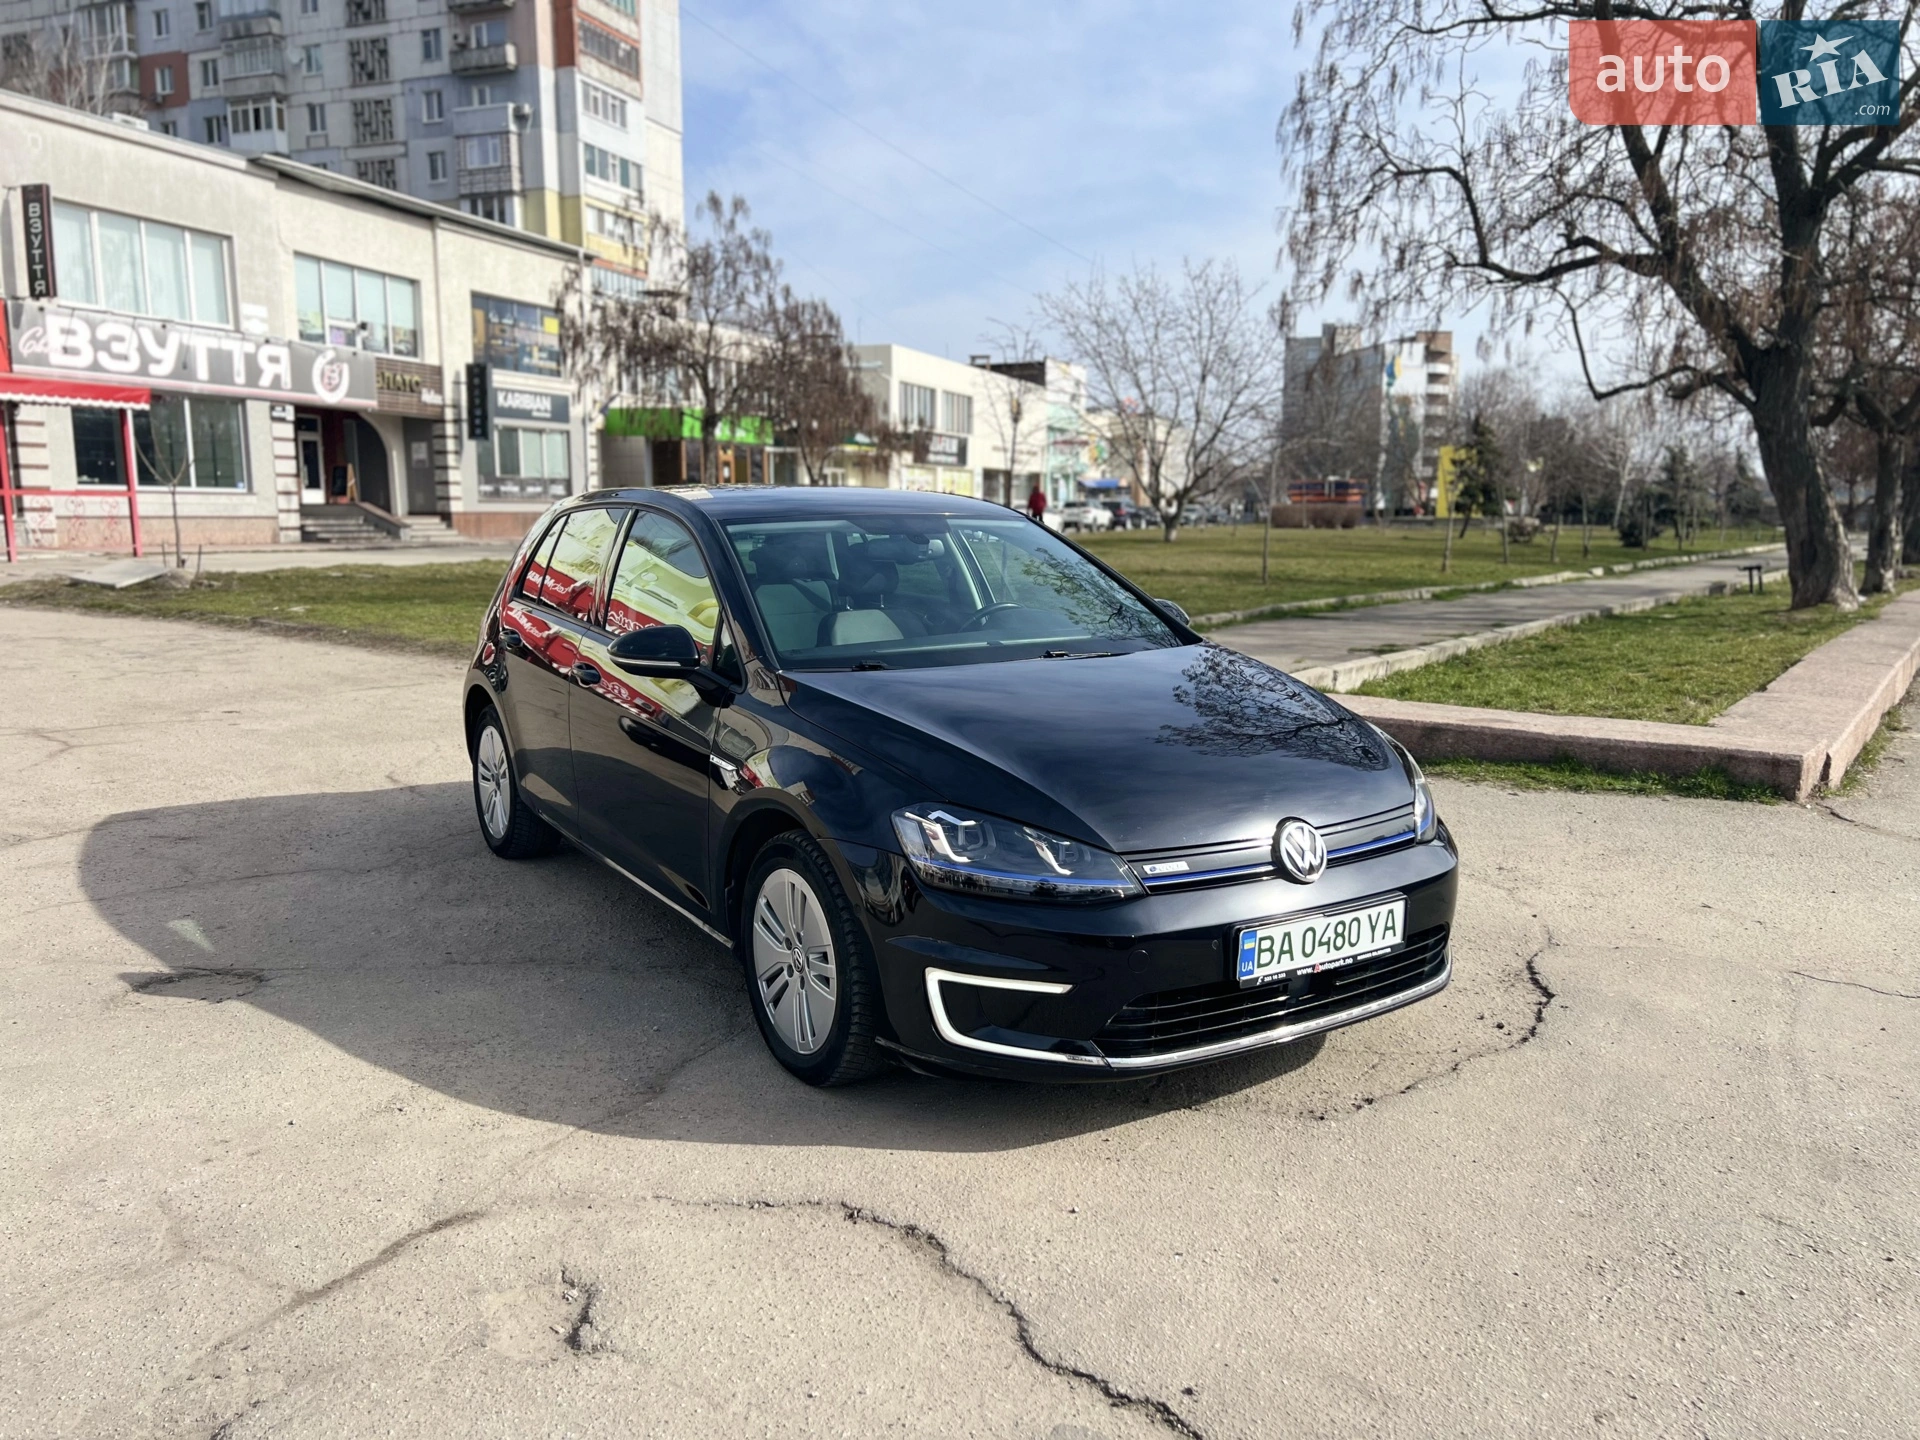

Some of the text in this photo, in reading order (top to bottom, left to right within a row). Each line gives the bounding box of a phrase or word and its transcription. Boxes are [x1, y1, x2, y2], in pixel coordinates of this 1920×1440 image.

[28, 203, 46, 295] ВЗУТТЯ
[45, 313, 292, 390] ВЗУТТЯ
[1241, 961, 1254, 973] UA
[1256, 908, 1397, 969] BA 0480 YA
